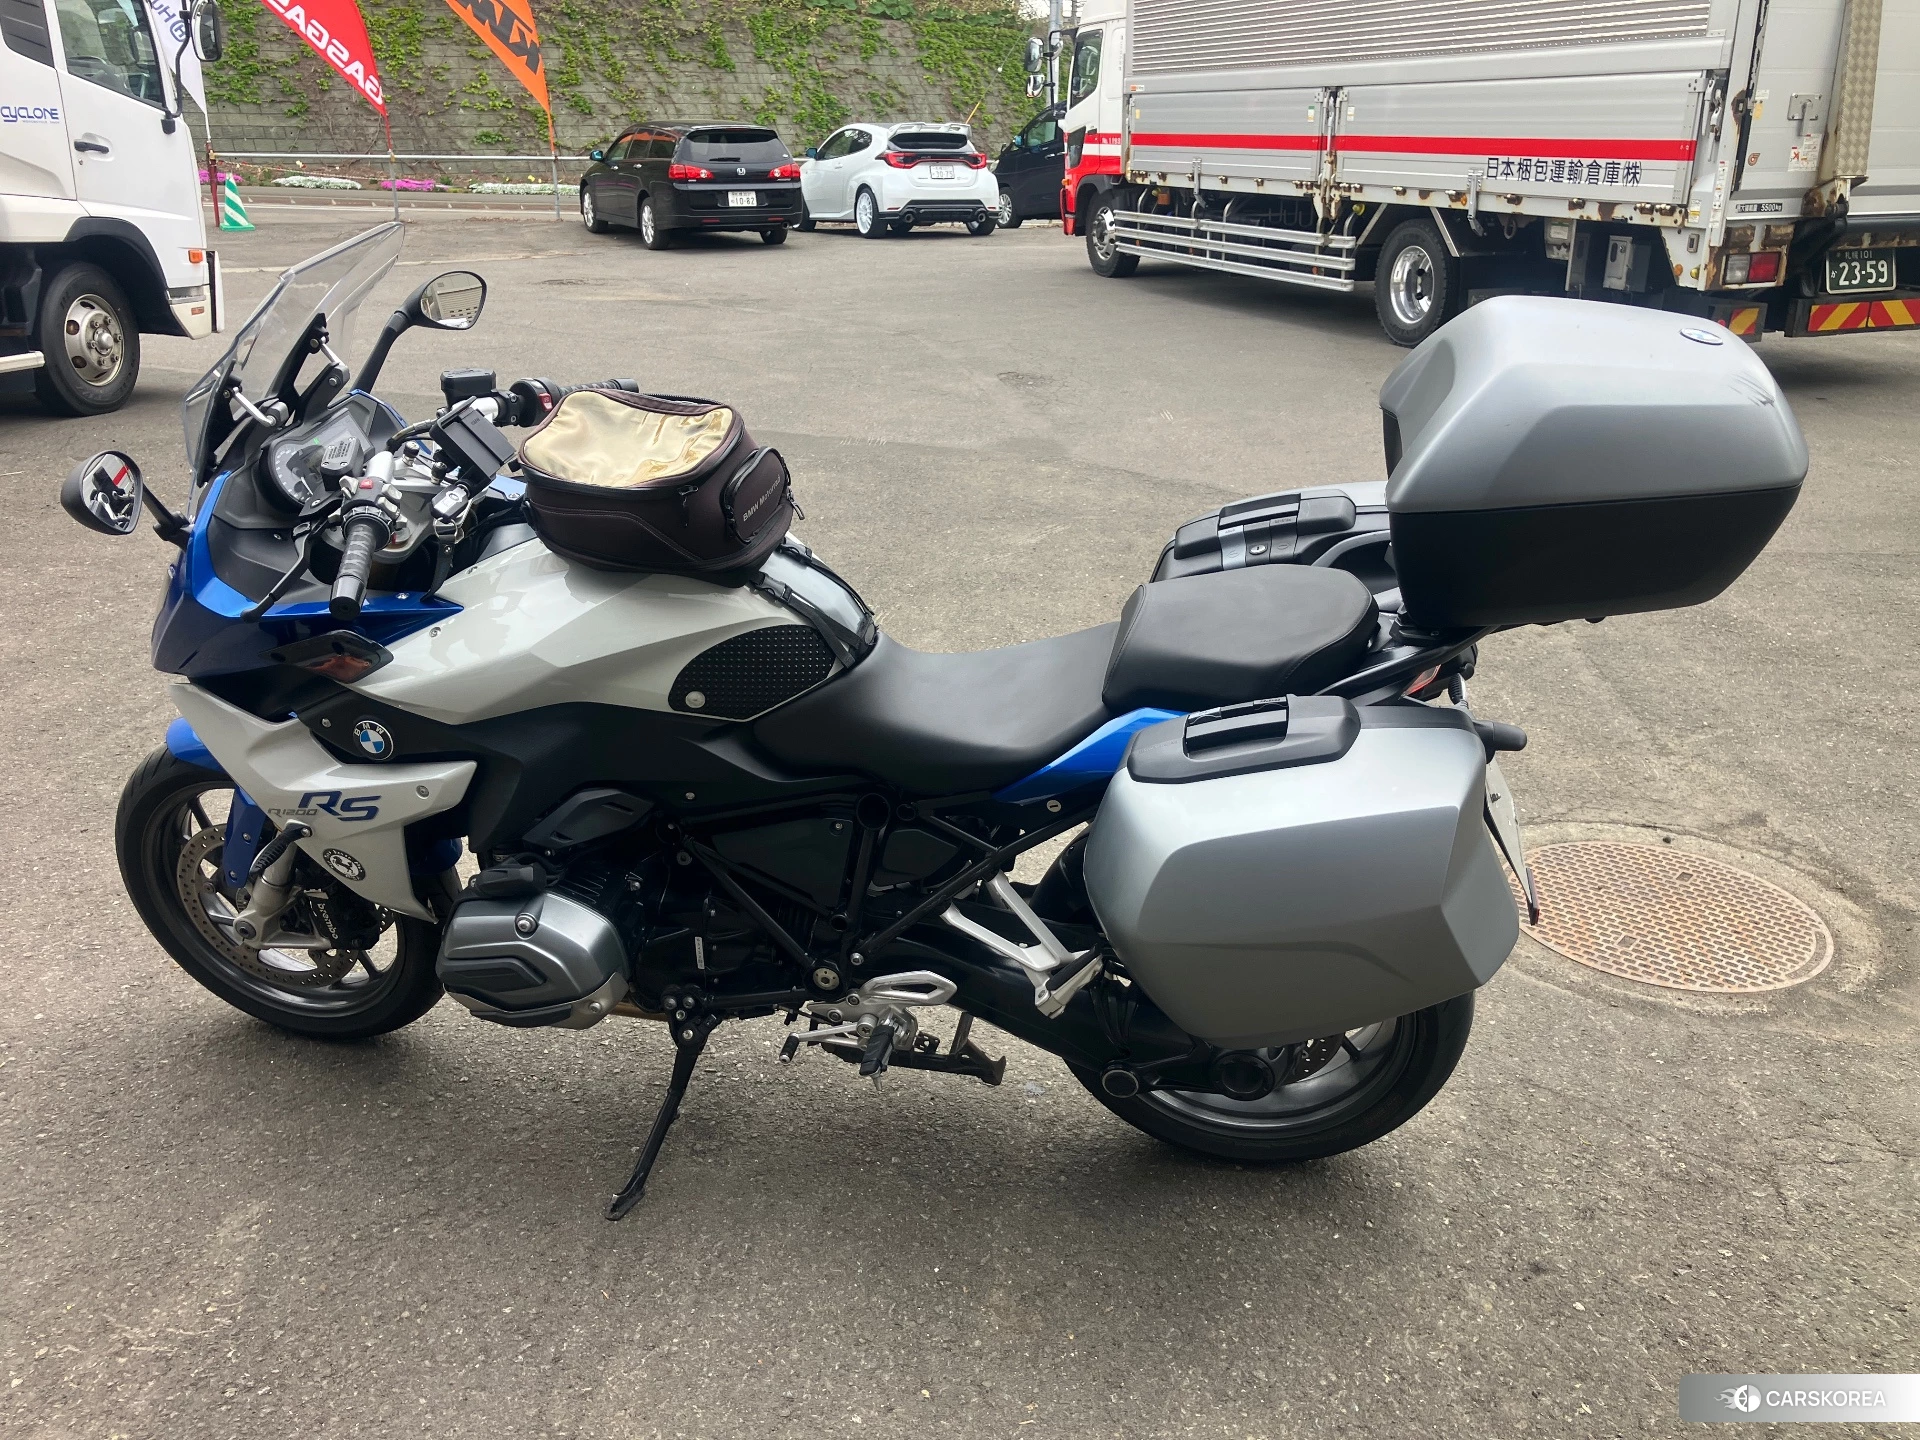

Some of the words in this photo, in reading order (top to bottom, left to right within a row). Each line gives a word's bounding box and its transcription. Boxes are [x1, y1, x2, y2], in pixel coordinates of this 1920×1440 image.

[1838, 260, 1888, 286] 23-59
[743, 502, 760, 521] BMW
[353, 722, 385, 737] BMW
[268, 808, 318, 818] R1200
[298, 790, 382, 822] RS
[317, 903, 339, 940] brembo
